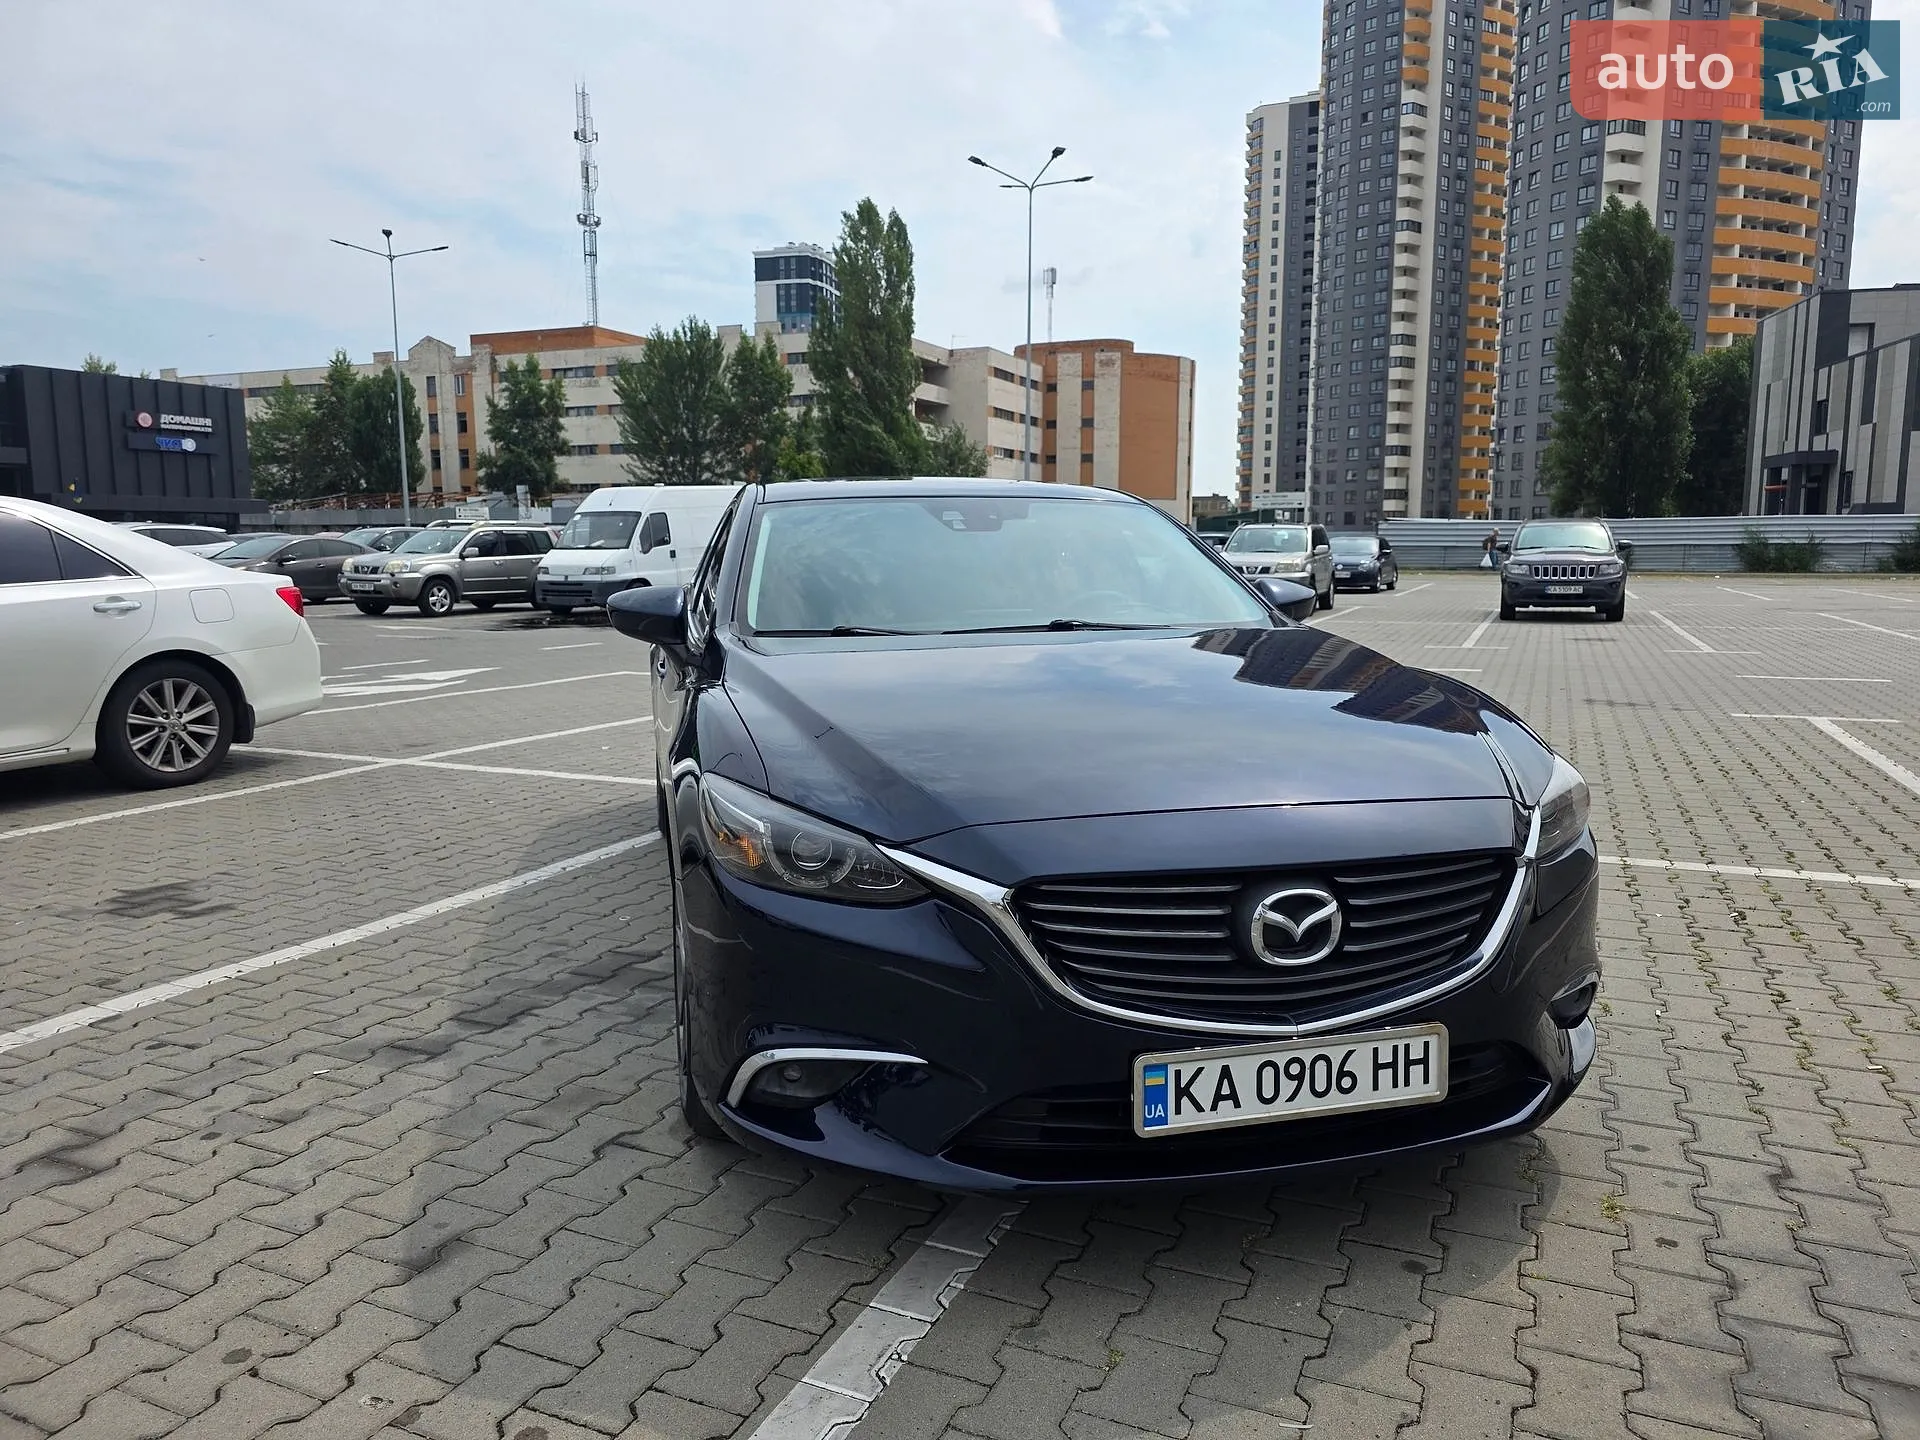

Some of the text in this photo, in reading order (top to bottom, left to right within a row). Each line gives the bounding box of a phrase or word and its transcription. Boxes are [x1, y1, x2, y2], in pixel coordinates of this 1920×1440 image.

[1144, 1040, 1430, 1119] UA KA 0906 HH
